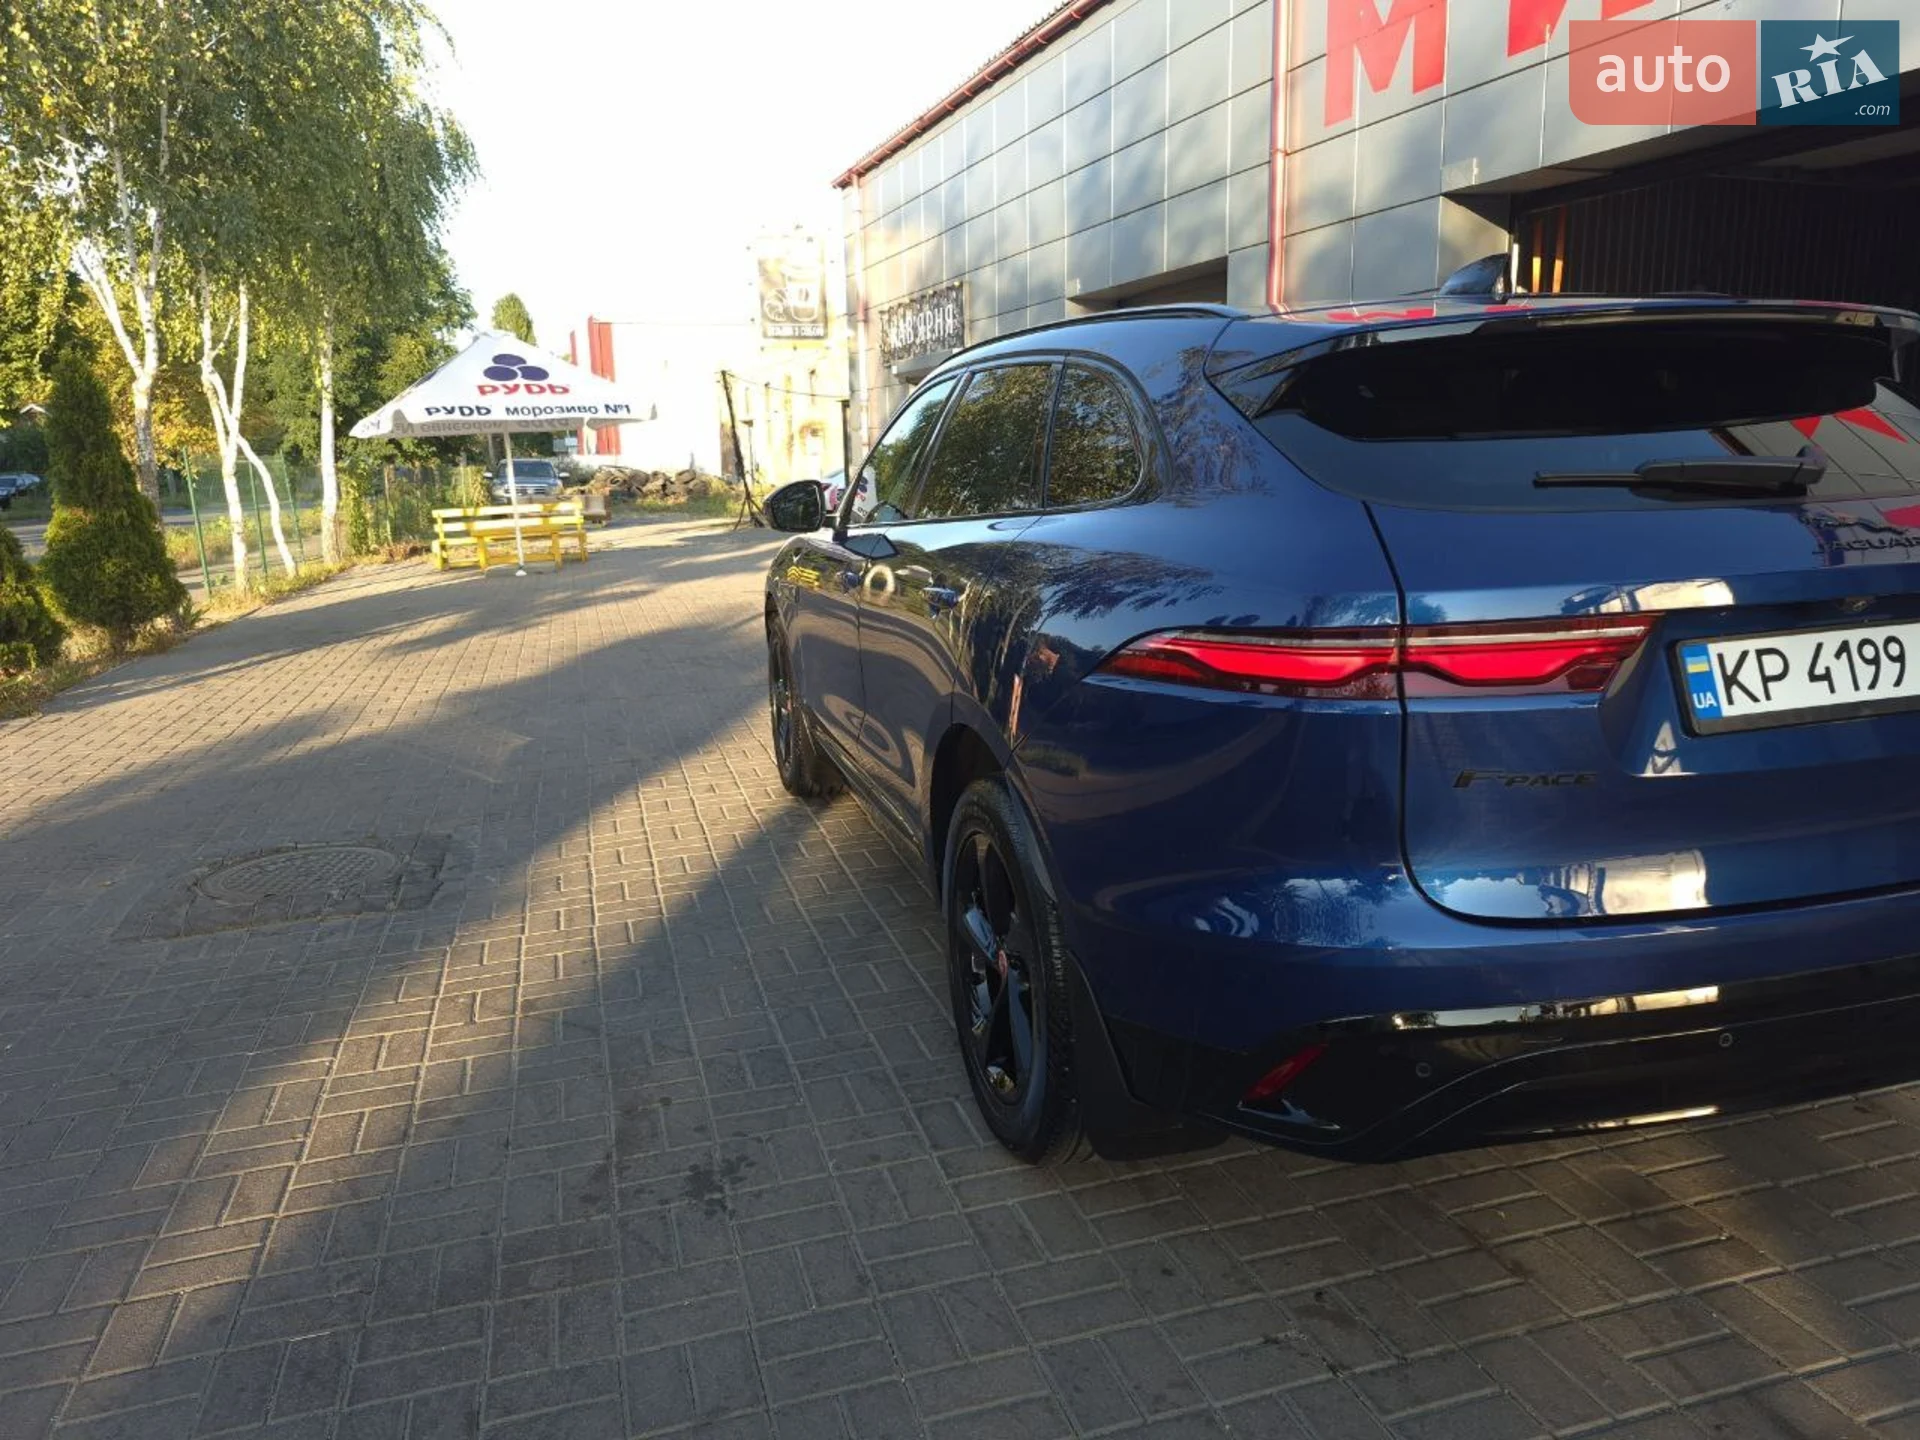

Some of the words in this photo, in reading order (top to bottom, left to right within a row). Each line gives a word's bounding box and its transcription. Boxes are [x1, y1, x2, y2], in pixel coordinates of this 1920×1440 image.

[477, 384, 570, 396] РУДЬ
[425, 405, 492, 417] РУДЬ
[505, 404, 599, 418] морозиво
[1717, 647, 1790, 706] KP
[1808, 635, 1906, 694] 4199
[1692, 692, 1719, 709] UA
[1452, 768, 1598, 788] F-PACE
